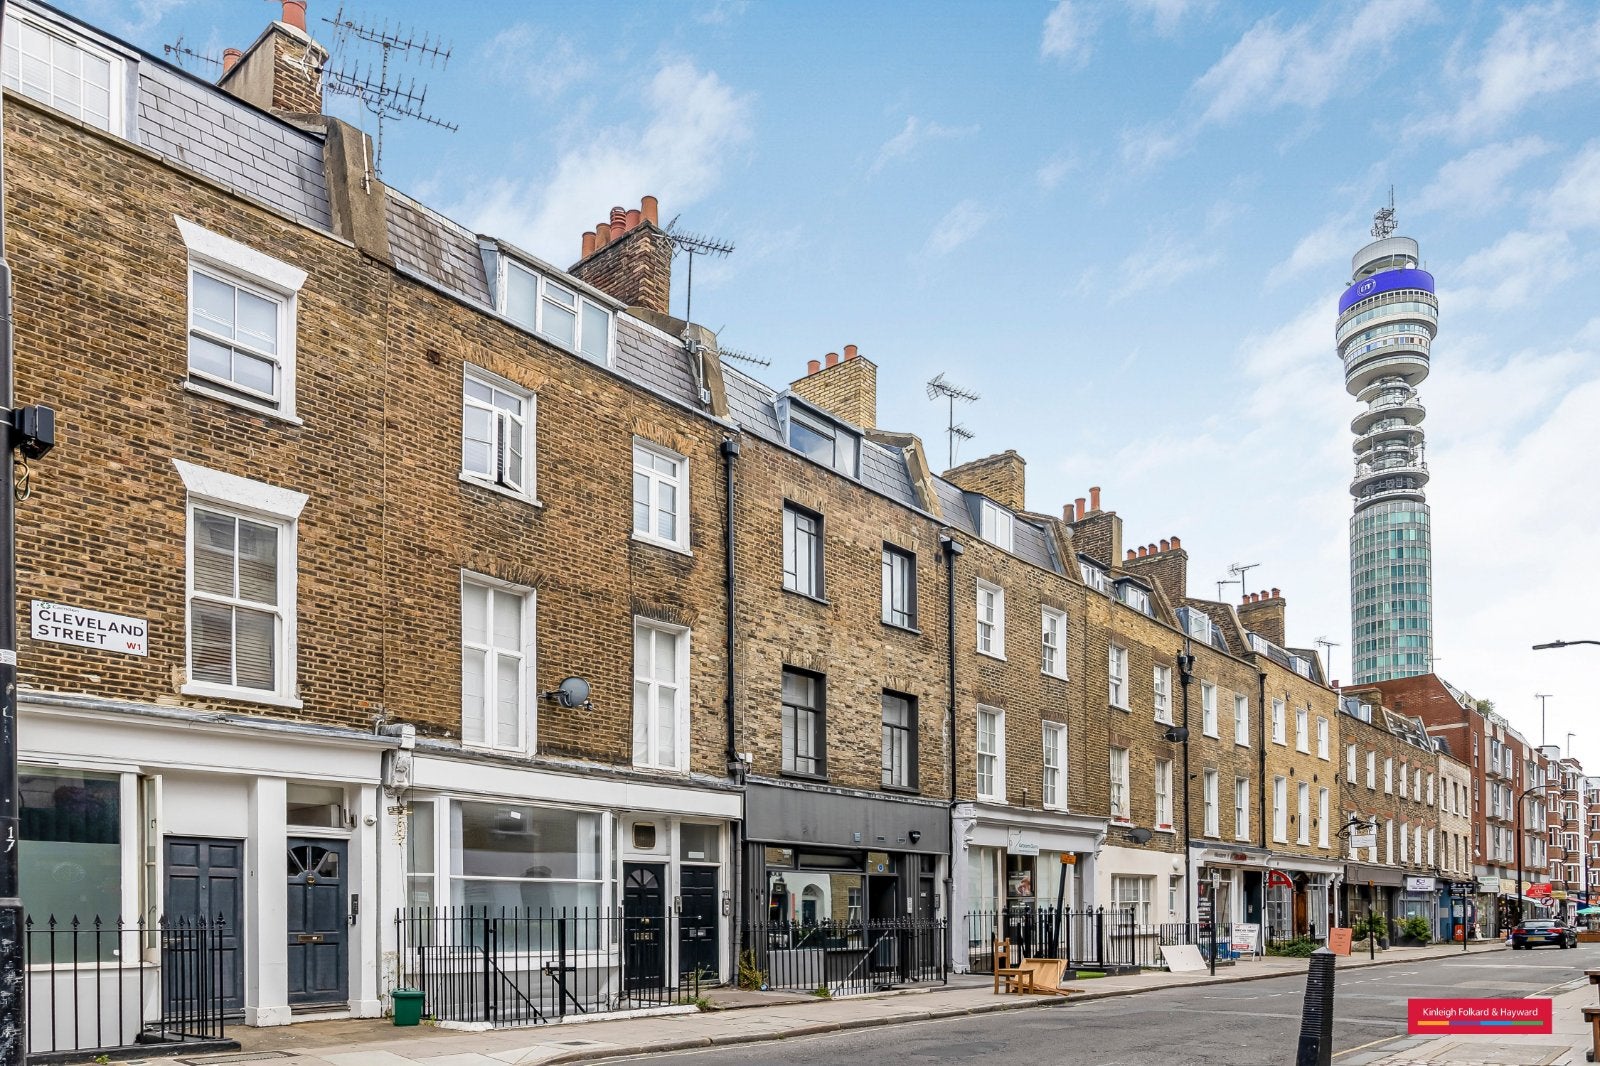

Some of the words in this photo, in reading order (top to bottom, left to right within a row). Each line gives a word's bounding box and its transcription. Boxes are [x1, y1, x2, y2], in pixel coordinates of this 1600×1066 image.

[38, 610, 144, 637] CLEVELAND
[38, 624, 107, 645] STREET
[126, 641, 142, 651] W1
